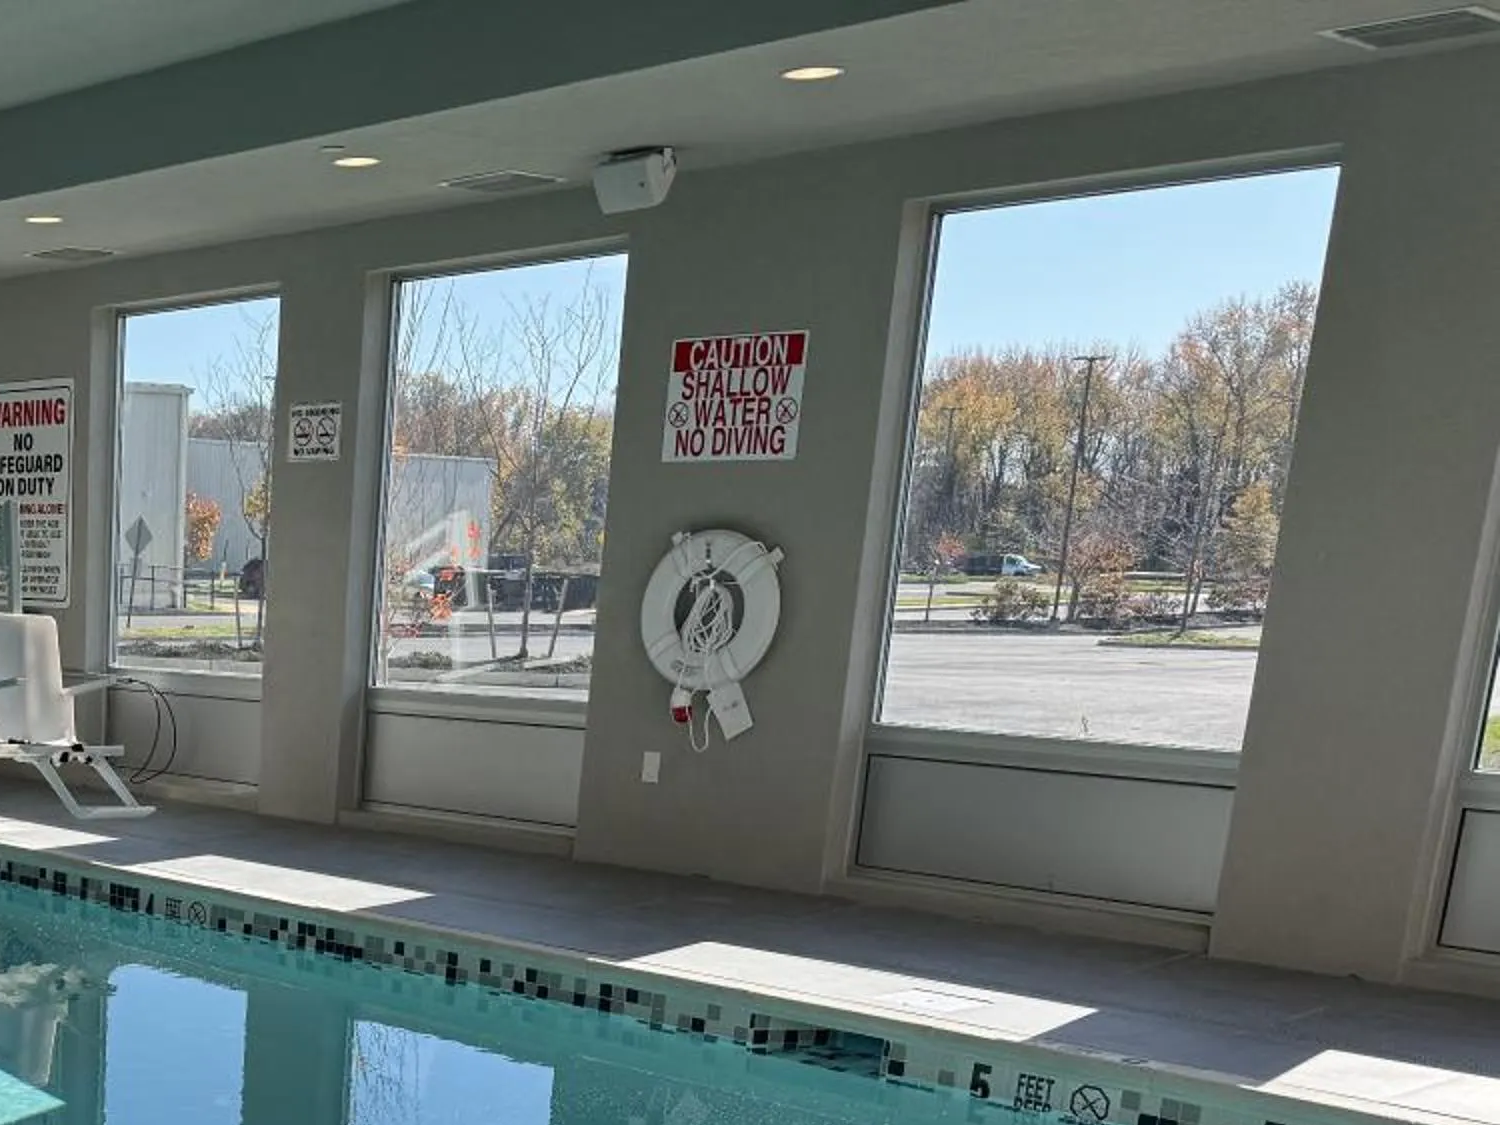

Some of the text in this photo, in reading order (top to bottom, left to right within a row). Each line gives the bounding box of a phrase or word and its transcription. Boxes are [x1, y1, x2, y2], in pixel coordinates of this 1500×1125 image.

[689, 335, 789, 371] CAUTION
[681, 366, 792, 400] SHALLOW
[694, 398, 771, 427] WATER
[13, 433, 33, 451] NO
[675, 426, 786, 457] NO DIVING
[18, 477, 55, 495] DUTY
[970, 1062, 992, 1099] 5
[1016, 1073, 1055, 1101] FEET
